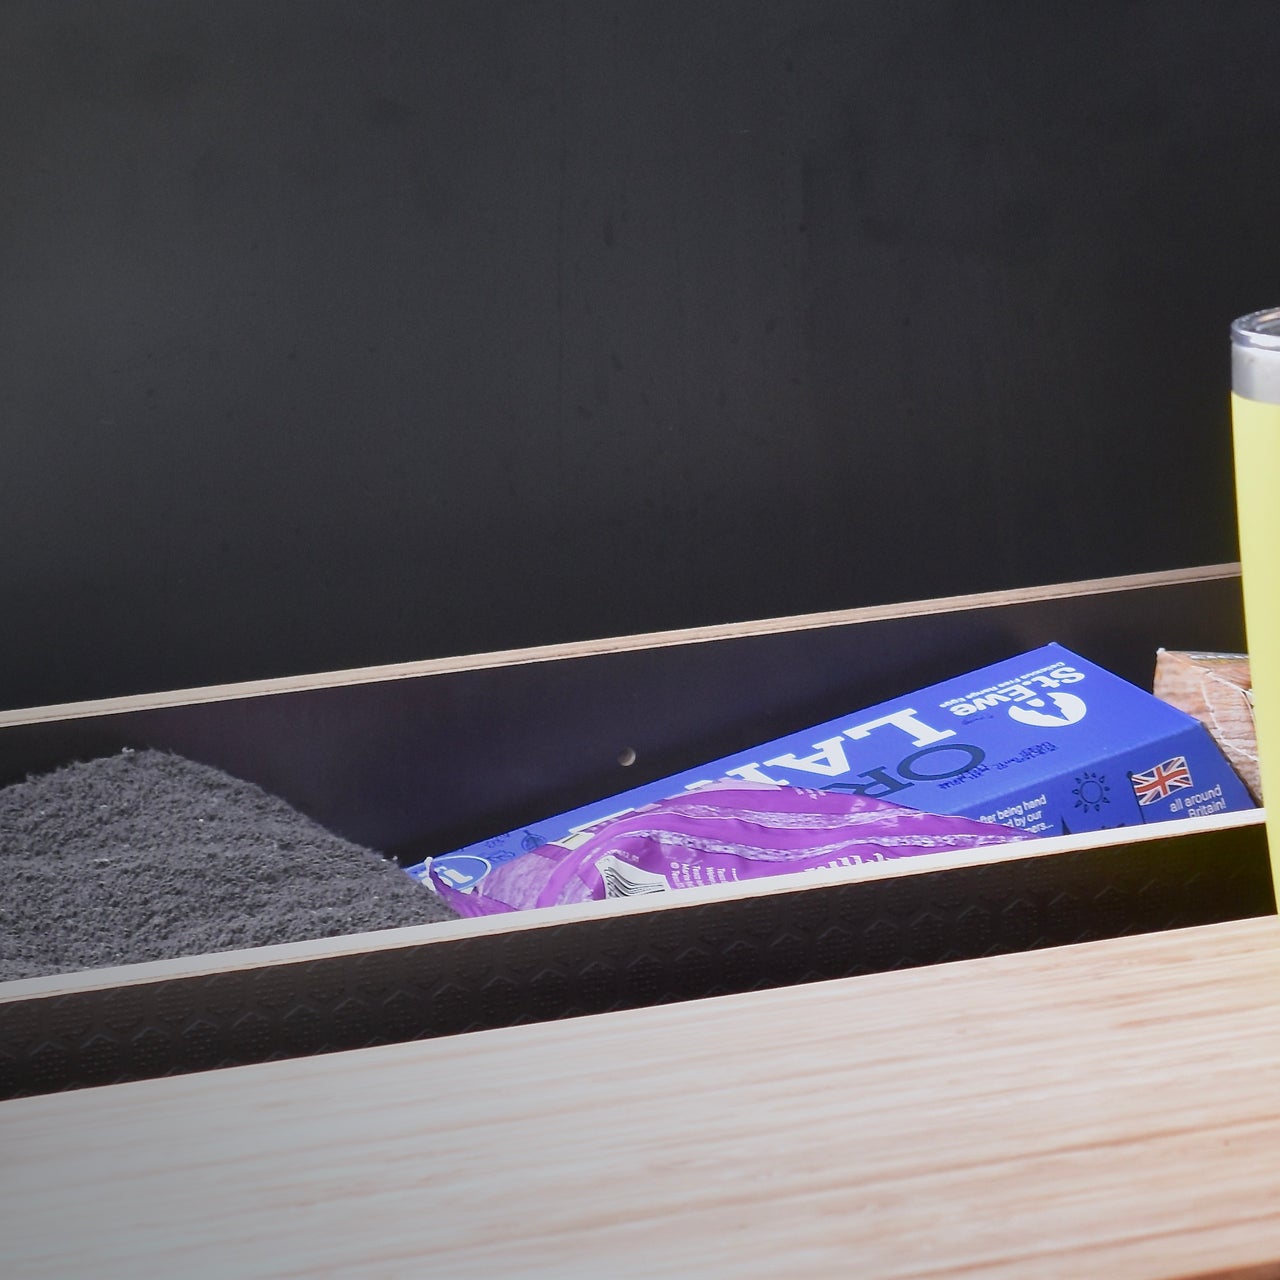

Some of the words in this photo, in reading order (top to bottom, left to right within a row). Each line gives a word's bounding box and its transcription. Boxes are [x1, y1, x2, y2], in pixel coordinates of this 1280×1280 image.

[996, 805, 1024, 820] being
[1022, 793, 1047, 811] hand
[1169, 798, 1184, 813] all
[1184, 783, 1222, 807] around
[1188, 797, 1227, 818] Britain!
[1026, 810, 1042, 823] our
